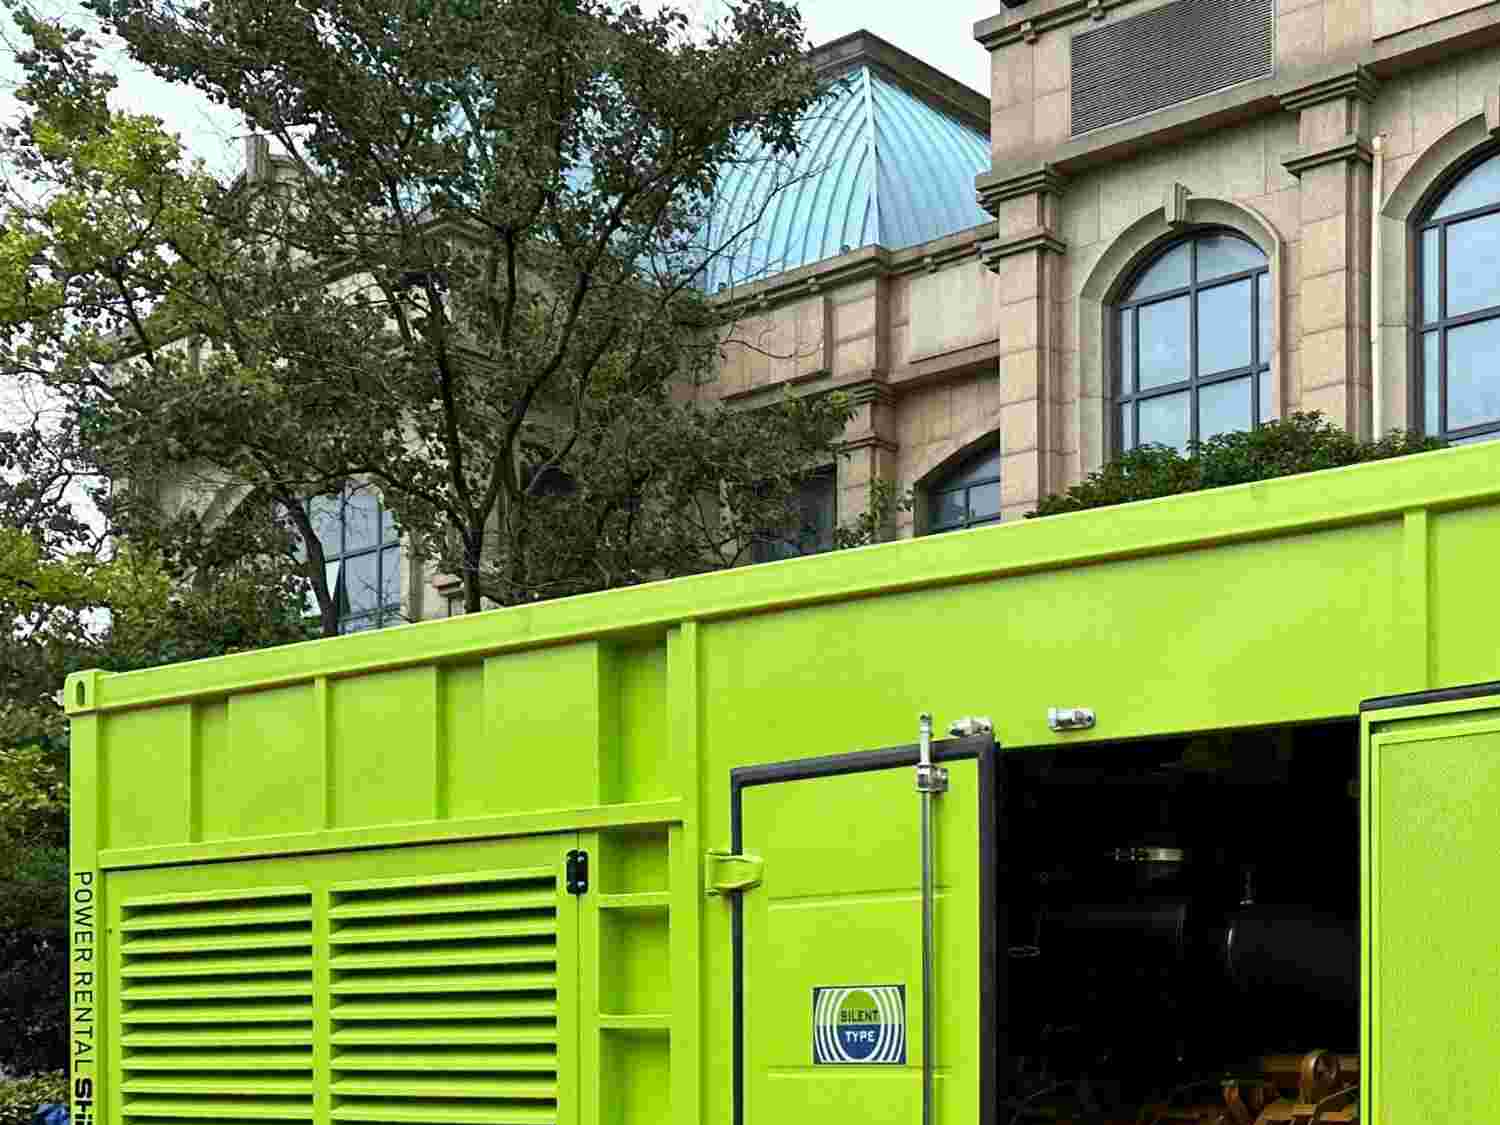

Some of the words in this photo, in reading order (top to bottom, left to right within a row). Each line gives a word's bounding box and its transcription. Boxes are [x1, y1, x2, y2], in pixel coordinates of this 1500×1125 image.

[74, 871, 94, 962] POWER
[74, 971, 94, 1073] RENTAL
[840, 1008, 879, 1023] SILENT
[845, 1030, 876, 1042] TYPE
